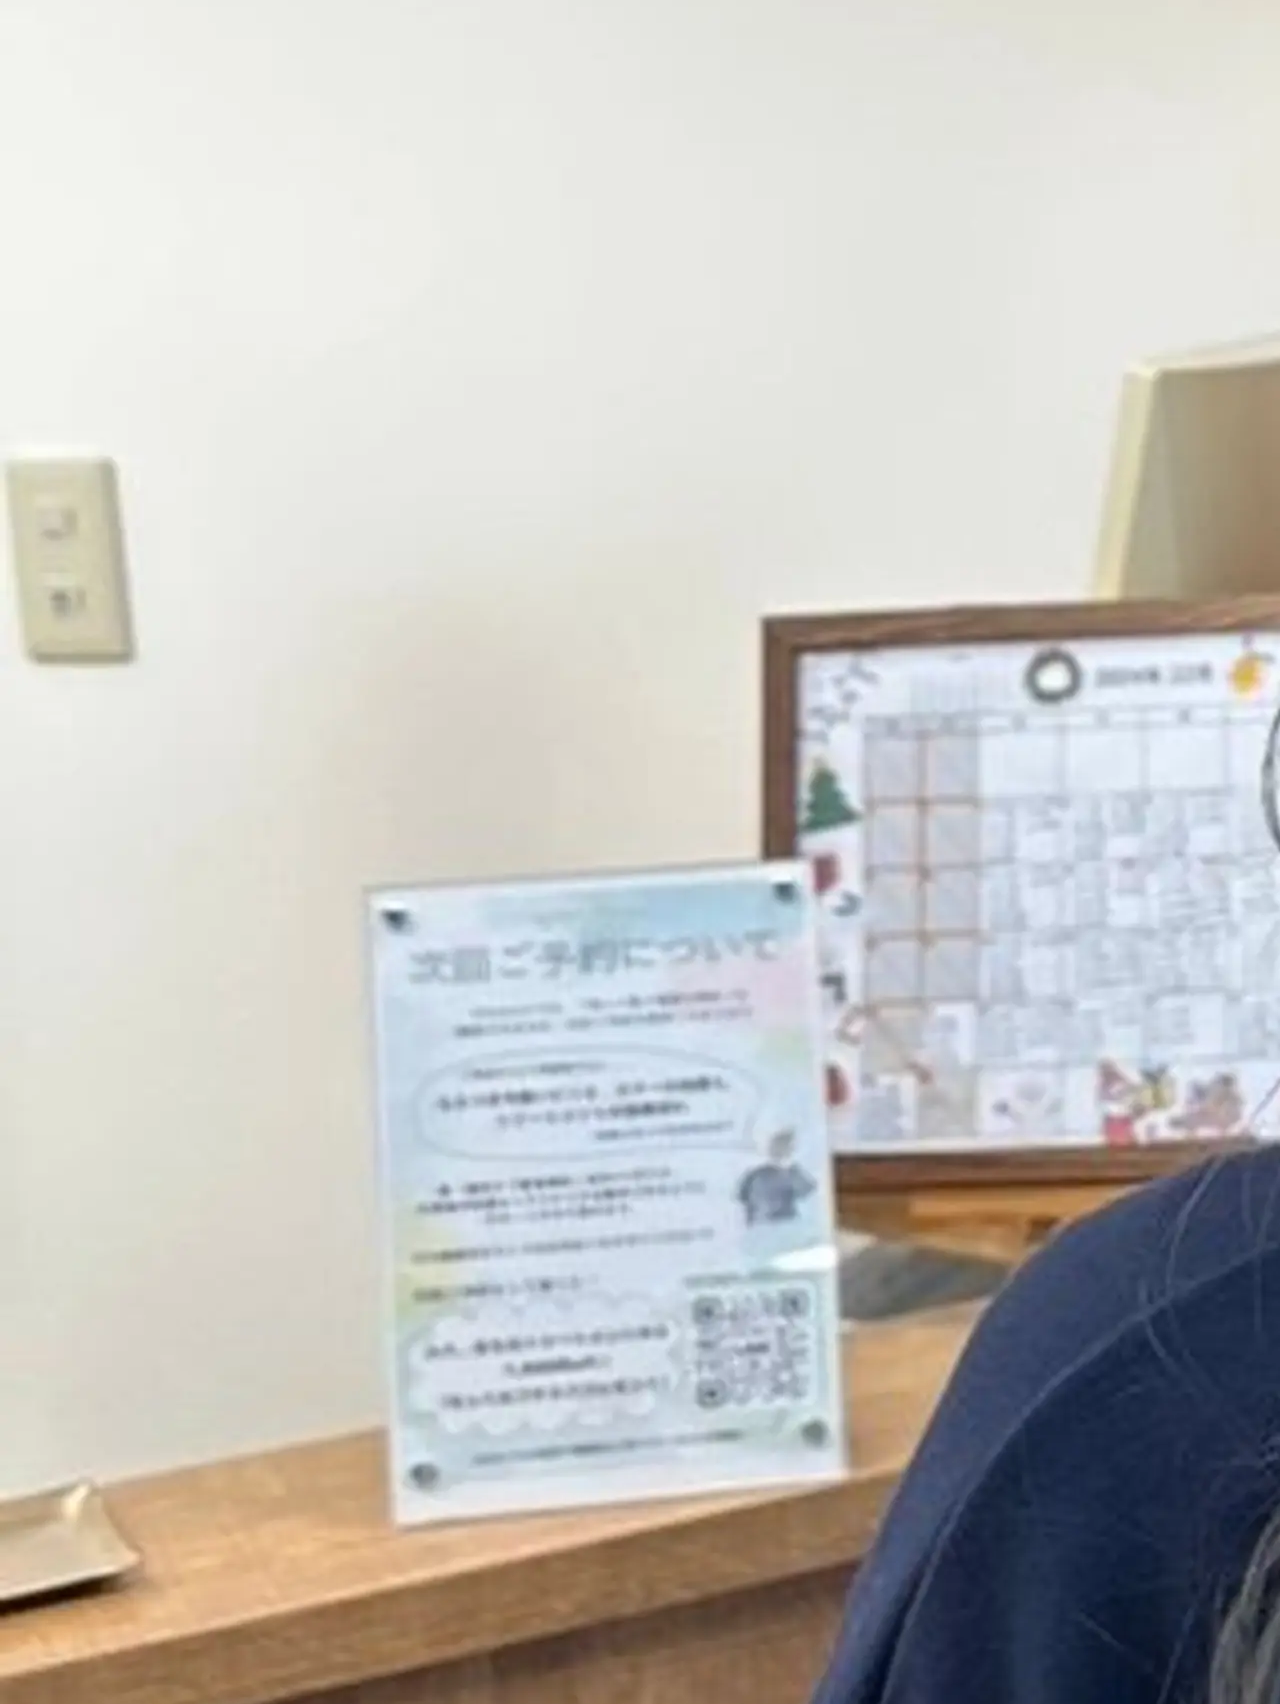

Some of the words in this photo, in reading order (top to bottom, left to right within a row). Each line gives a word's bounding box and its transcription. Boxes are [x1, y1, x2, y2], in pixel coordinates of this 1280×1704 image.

[406, 927, 780, 985] 次回ご予約について
